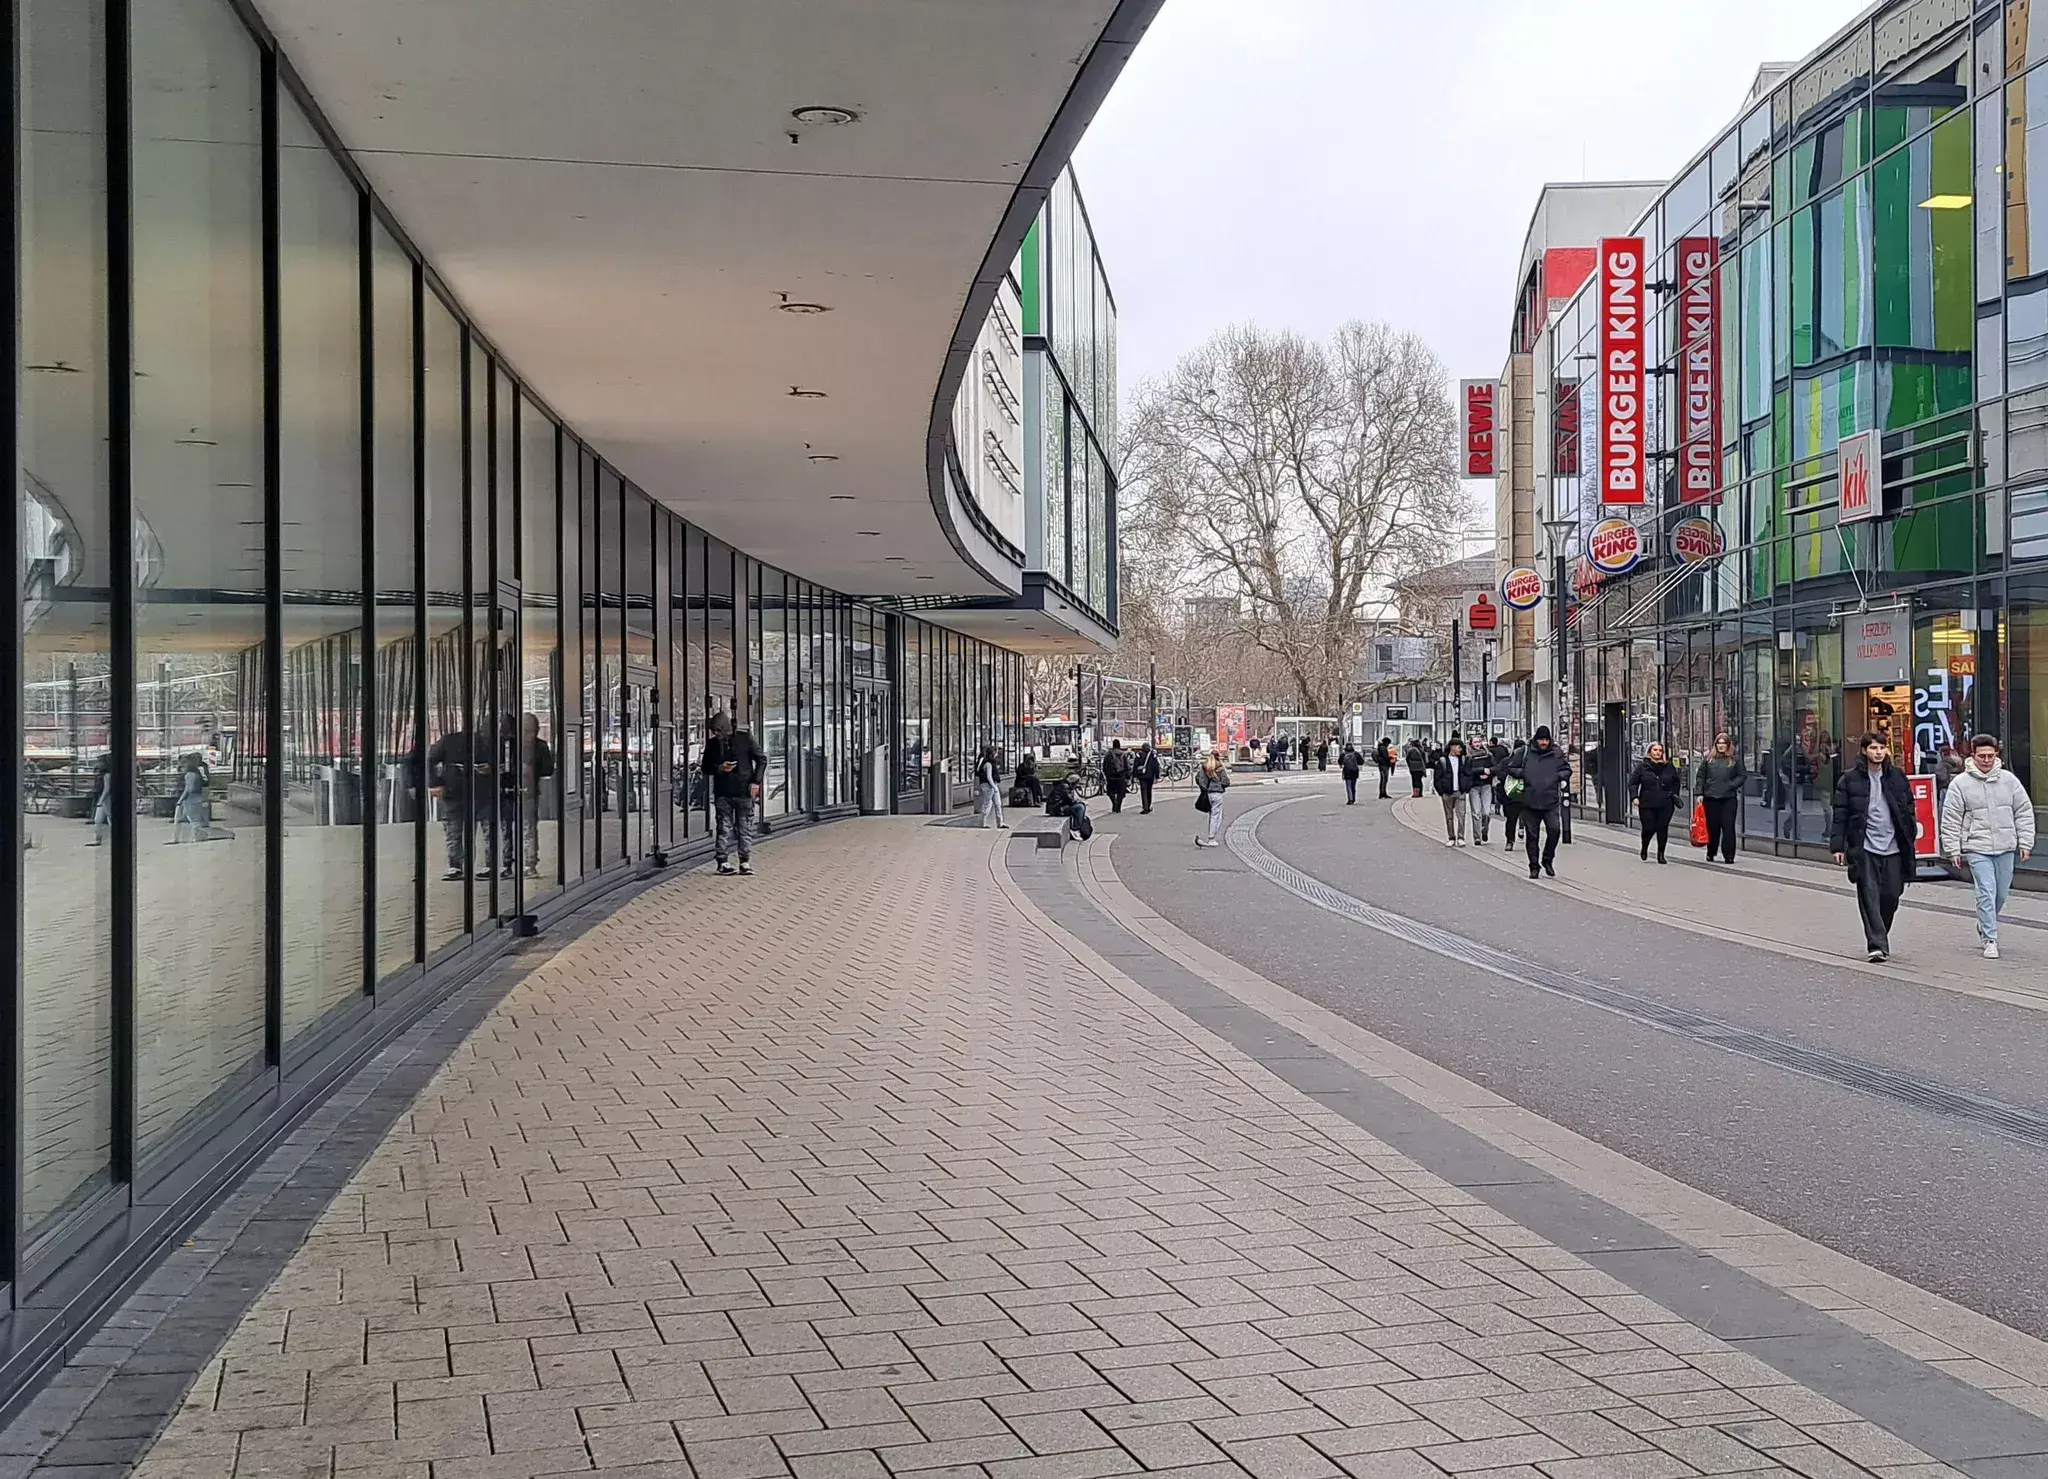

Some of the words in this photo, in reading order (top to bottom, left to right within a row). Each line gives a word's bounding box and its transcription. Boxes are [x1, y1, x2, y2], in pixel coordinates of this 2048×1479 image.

[1609, 252, 1636, 339] KING
[1468, 384, 1492, 474] REWE
[1609, 349, 1636, 489] BURGER
[1592, 526, 1635, 546] BURGER
[1593, 536, 1637, 563] KING
[1506, 575, 1539, 589] BURGER
[1508, 582, 1540, 601] KING
